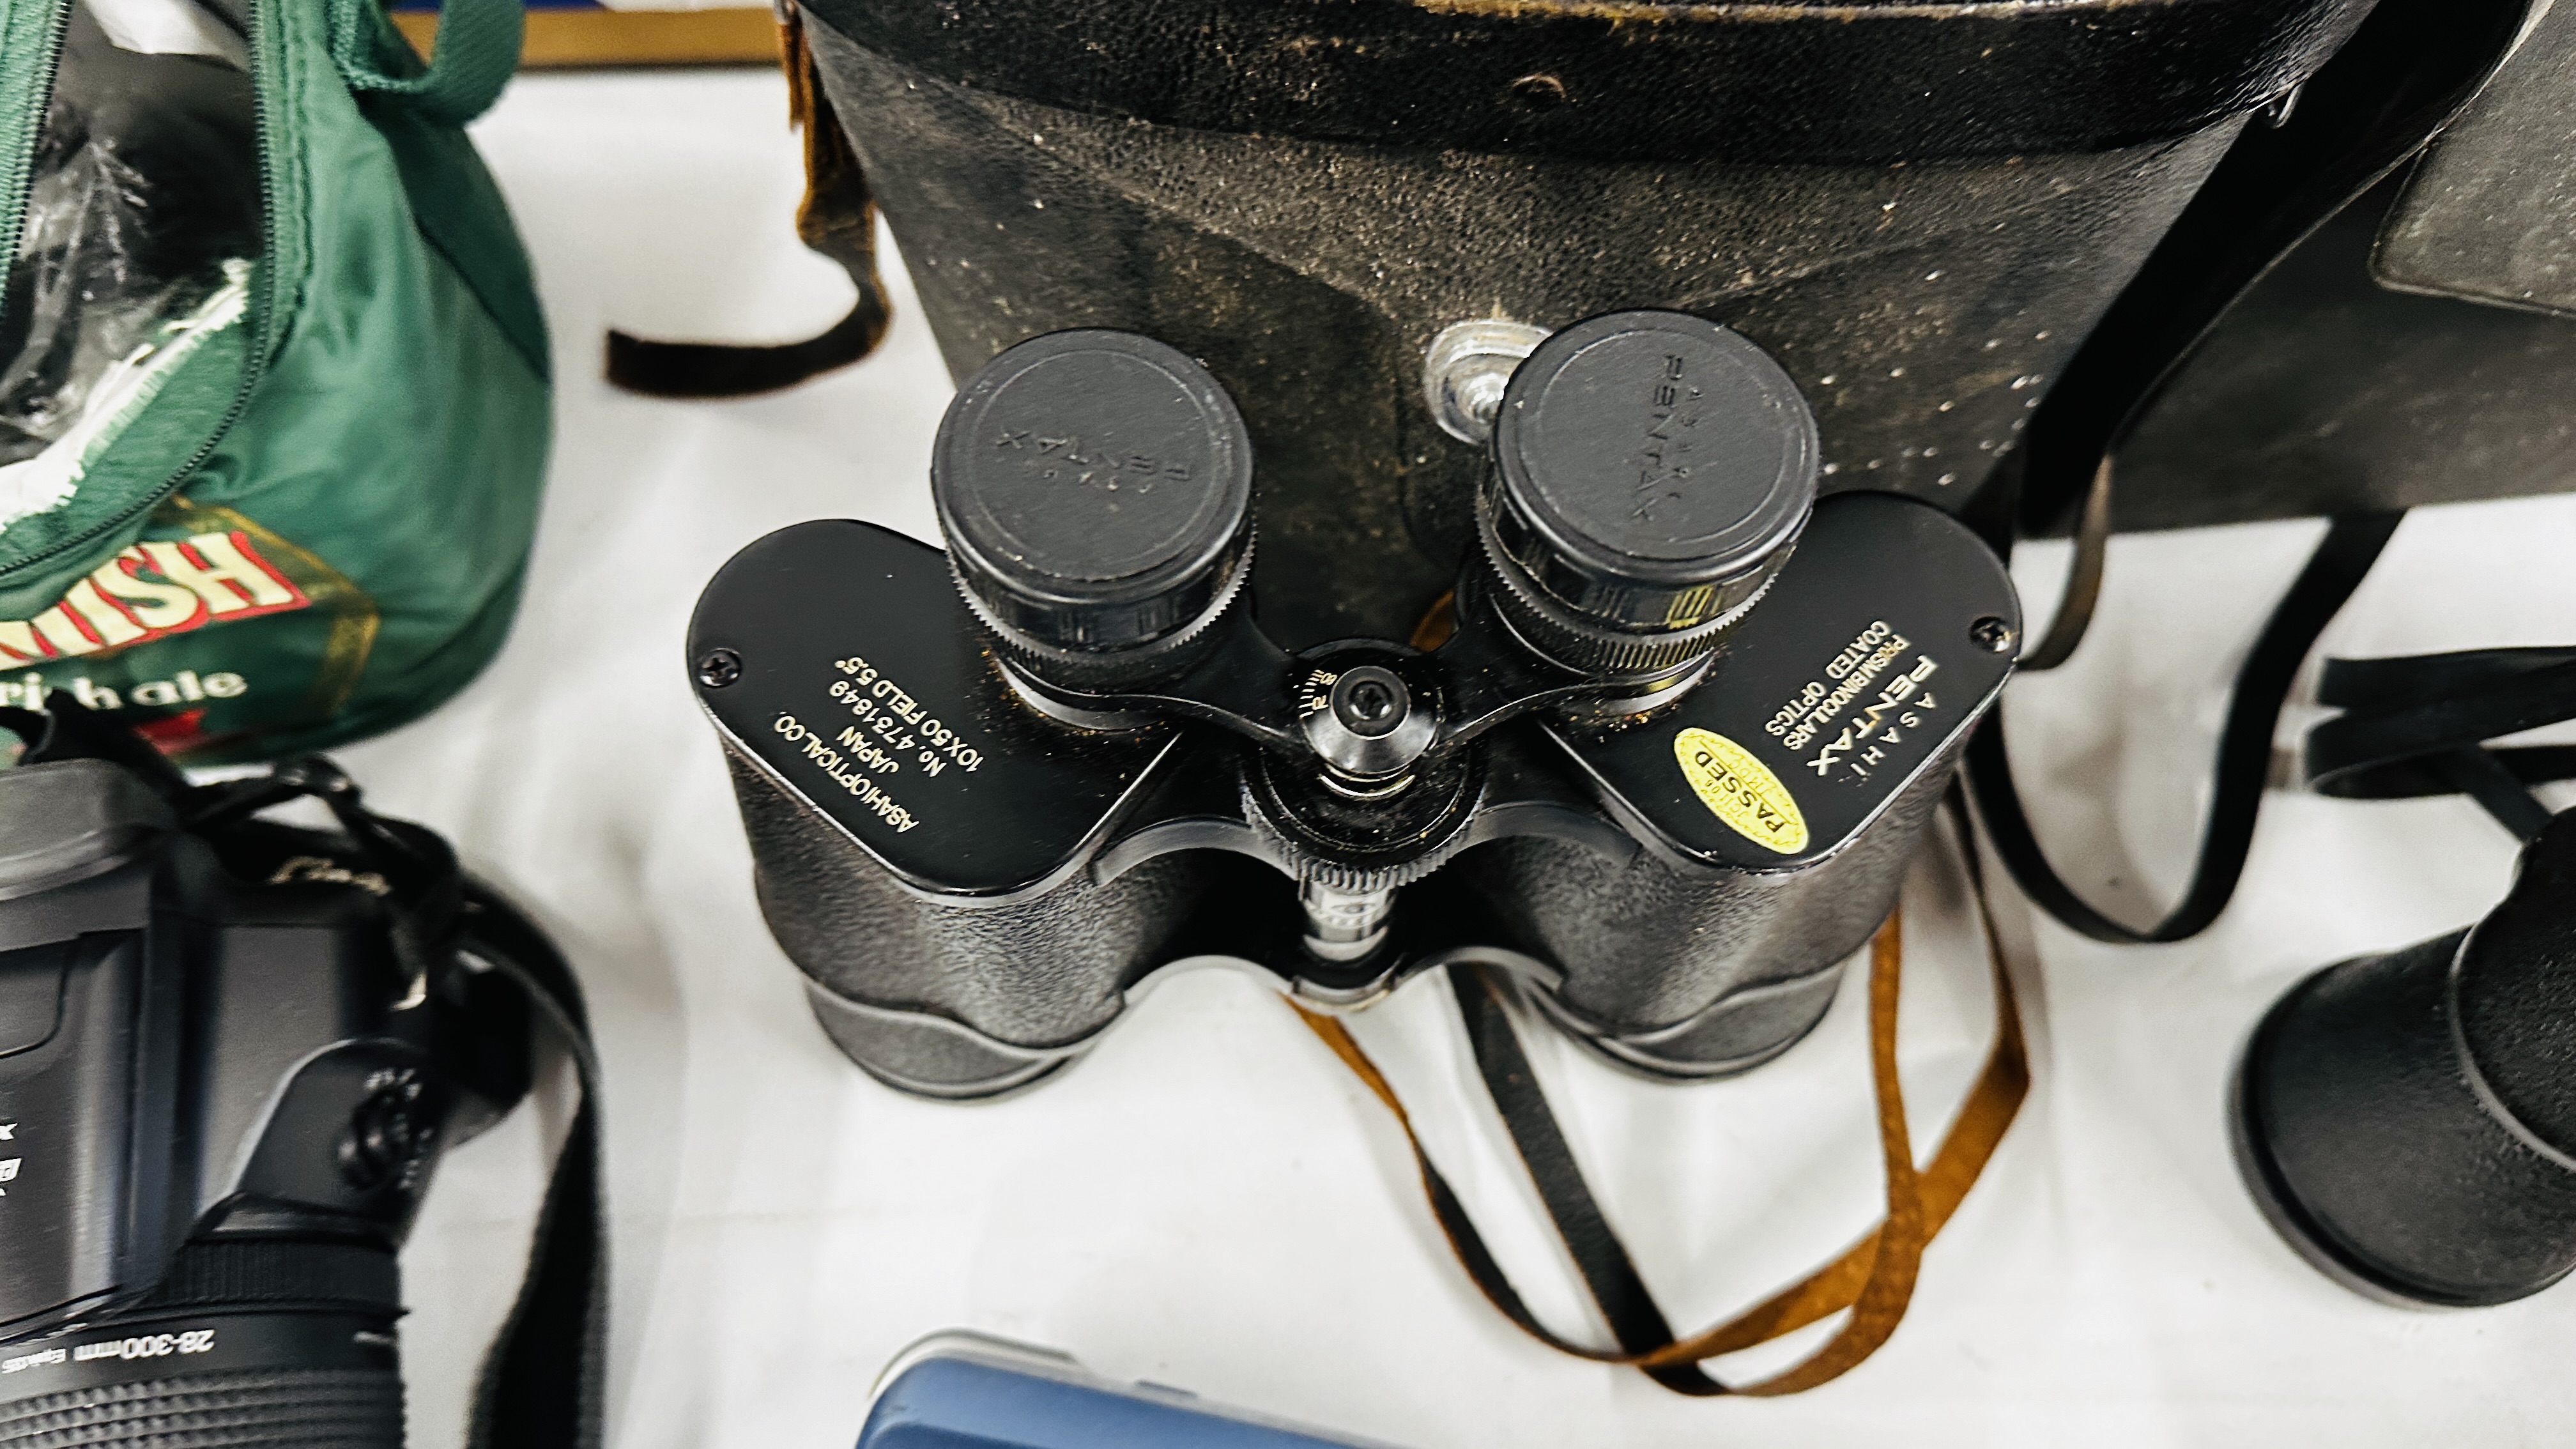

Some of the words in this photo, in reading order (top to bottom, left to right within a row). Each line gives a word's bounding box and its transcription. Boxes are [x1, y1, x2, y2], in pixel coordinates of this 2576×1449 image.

[1825, 620, 1892, 679] COATED
[130, 670, 249, 706] ale
[829, 680, 916, 750] 4731849
[872, 680, 928, 725] FIELD
[1765, 682, 1827, 736] OPTICS
[1806, 655, 1938, 776] PENTAX
[836, 726, 900, 773] JAPAN
[919, 746, 947, 777] No.
[1850, 692, 1936, 776] ASAHI
[802, 732, 871, 795] OPTICAL
[861, 786, 919, 832] ASAHI
[1694, 751, 1785, 833] PASSED
